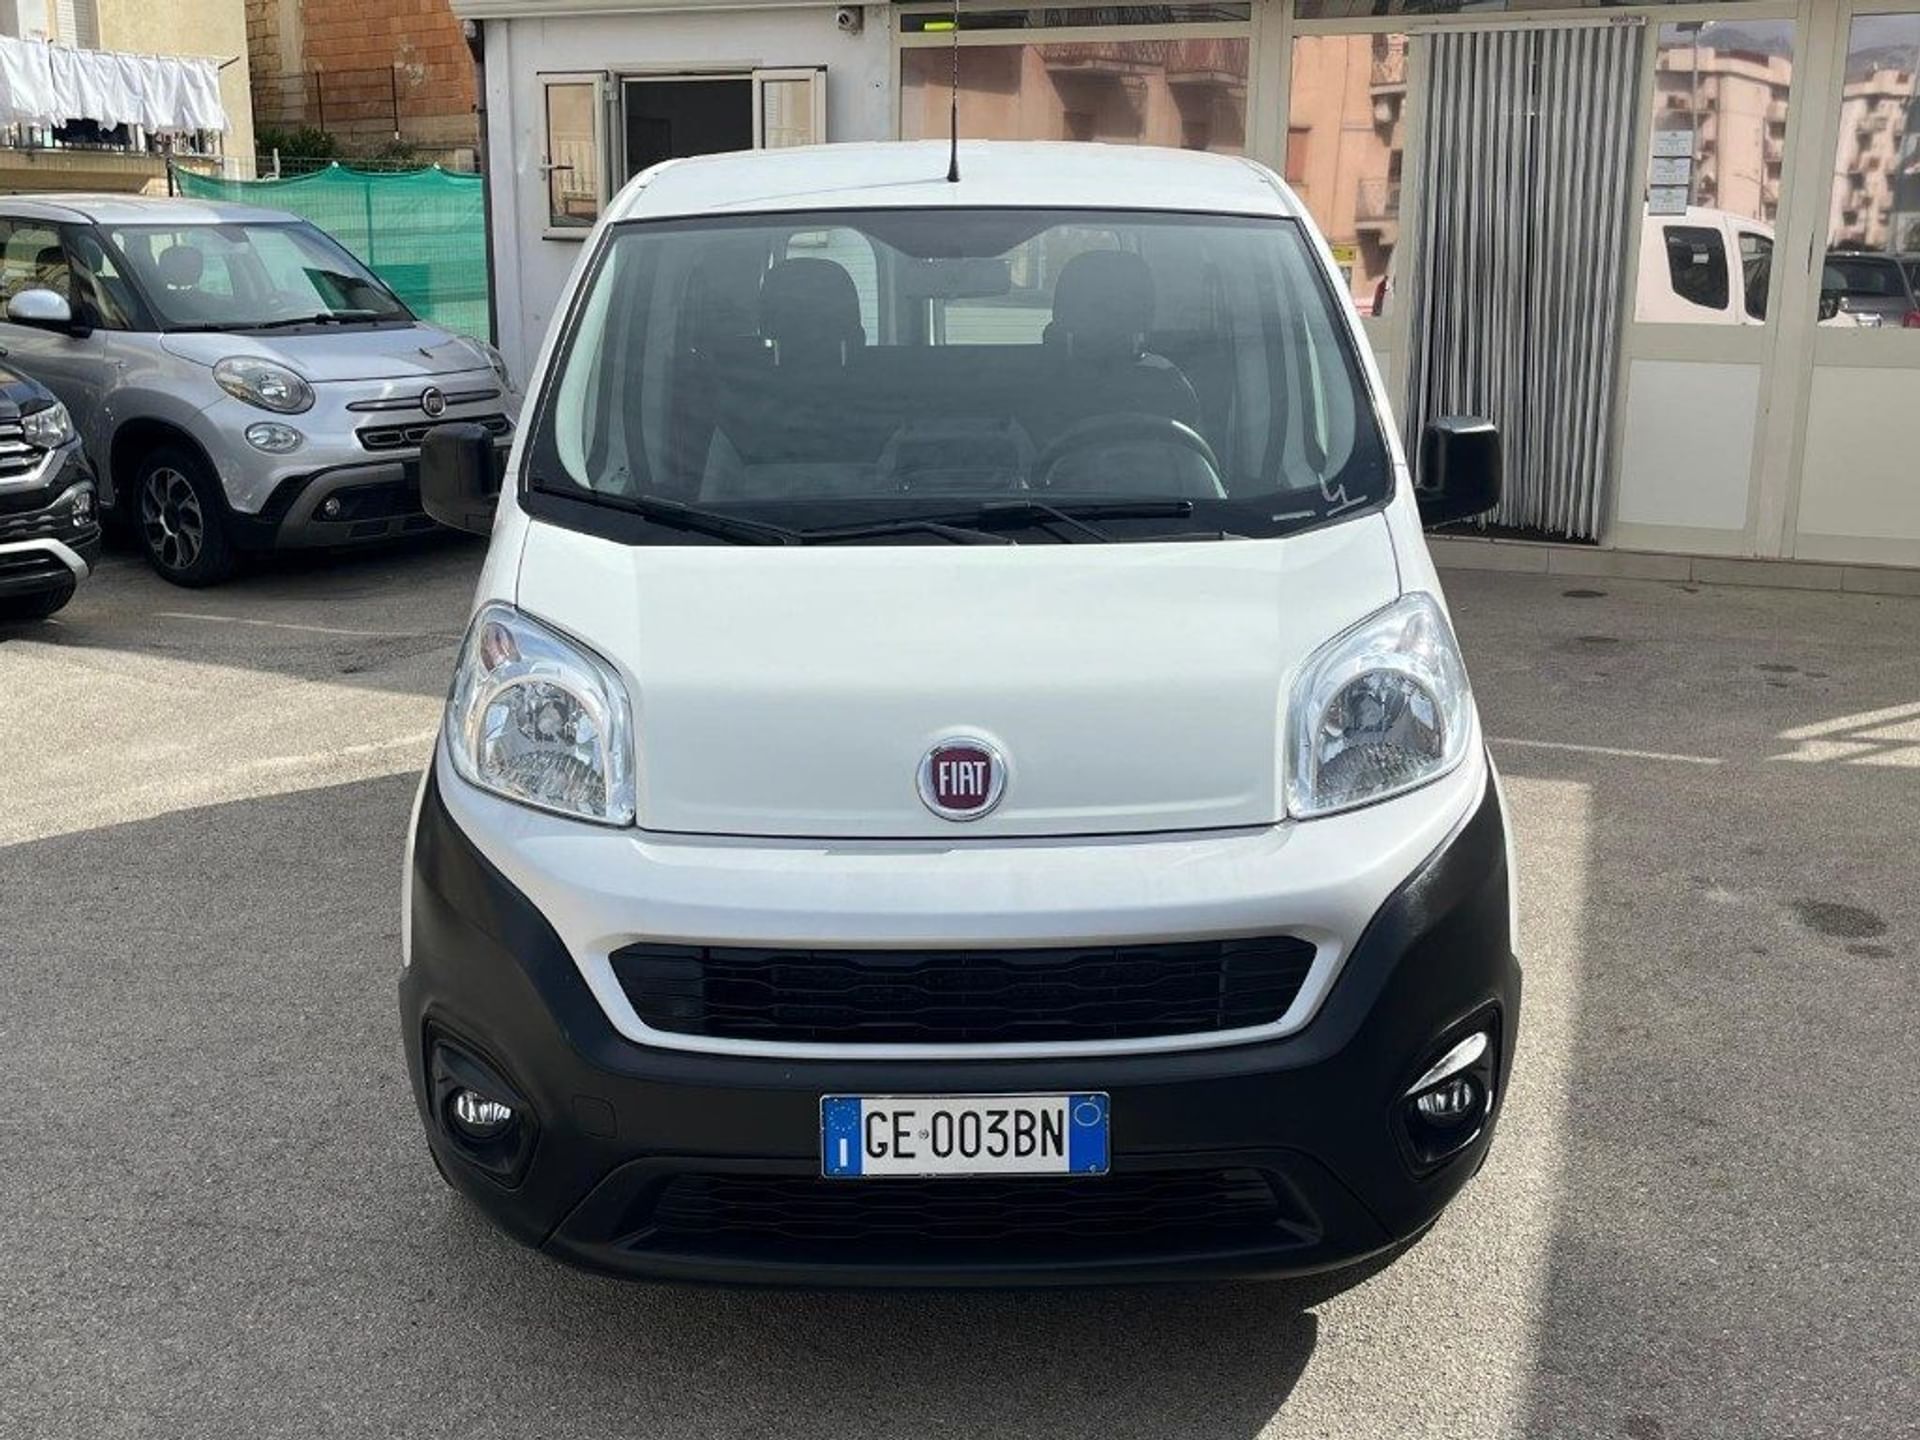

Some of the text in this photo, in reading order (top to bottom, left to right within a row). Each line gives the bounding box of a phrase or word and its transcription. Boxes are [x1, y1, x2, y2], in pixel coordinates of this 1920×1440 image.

[939, 761, 987, 796] FIAT
[865, 1109, 1064, 1159] GE 003BN
[839, 1138, 848, 1167] I
